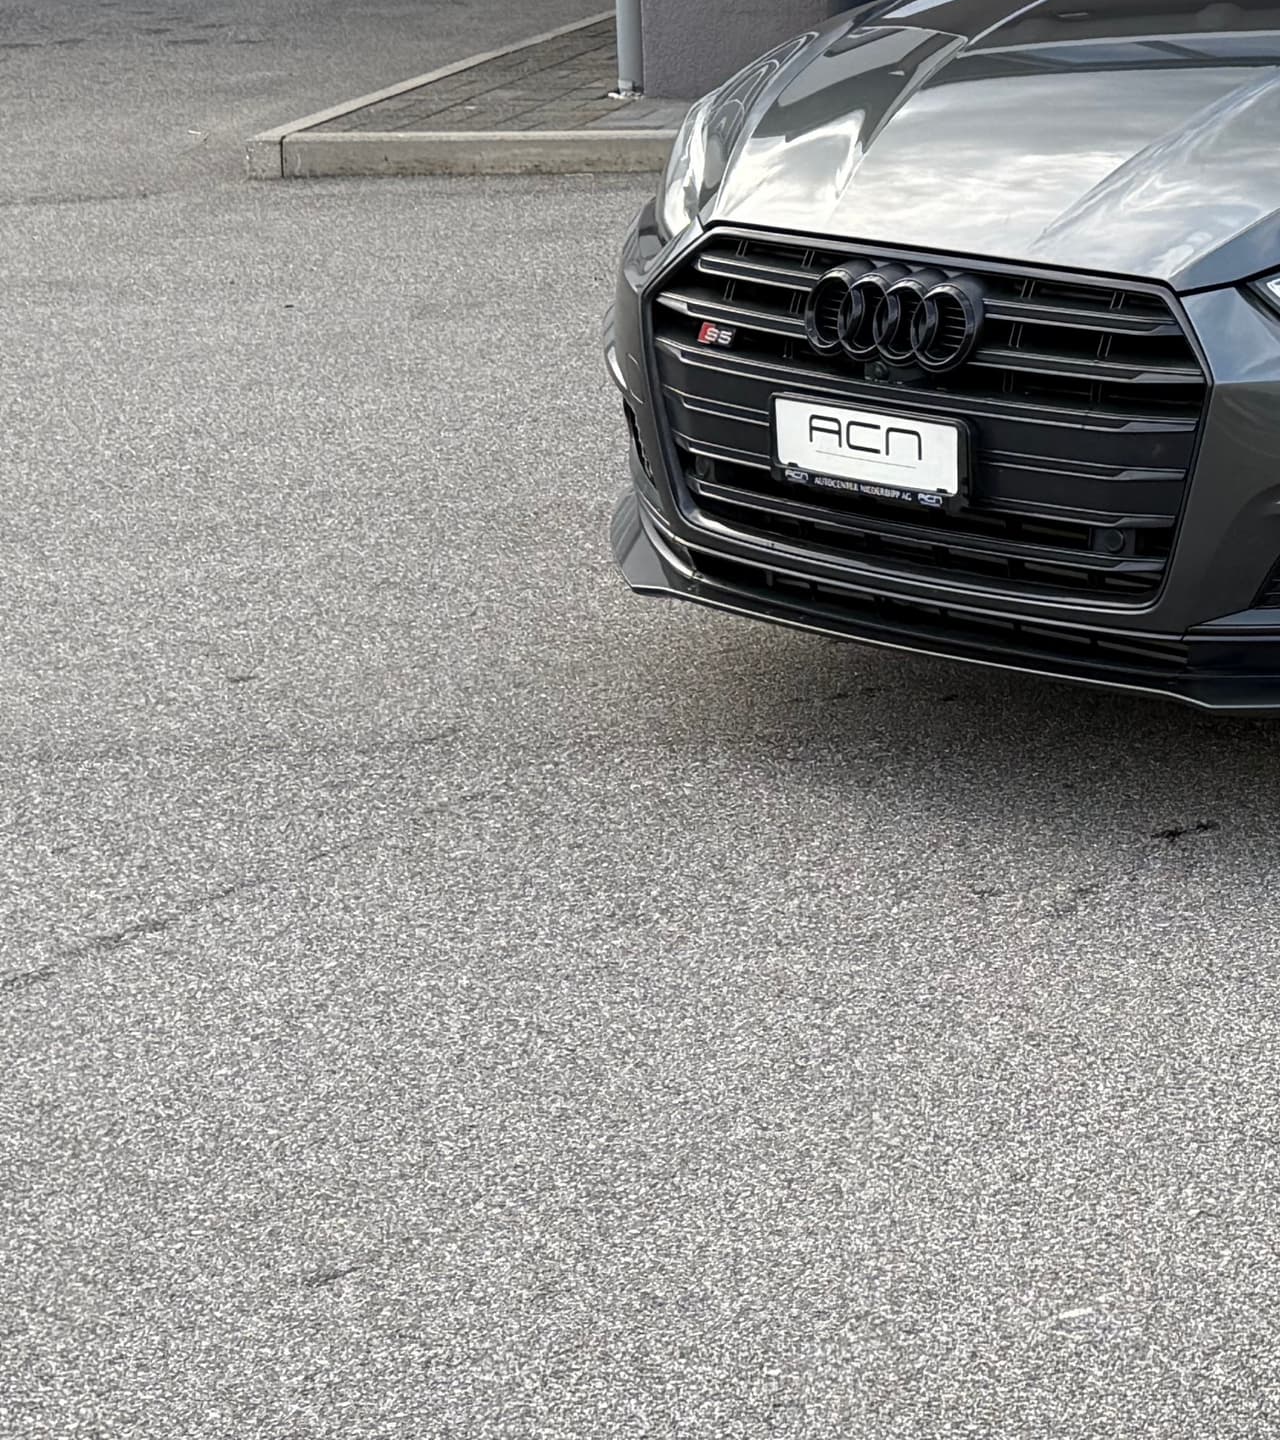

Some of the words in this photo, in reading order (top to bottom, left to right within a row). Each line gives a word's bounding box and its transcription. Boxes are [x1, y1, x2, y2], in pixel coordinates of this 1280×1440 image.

[704, 326, 732, 345] S5
[809, 414, 922, 460] ACN
[814, 477, 859, 492] AUTOCENTER
